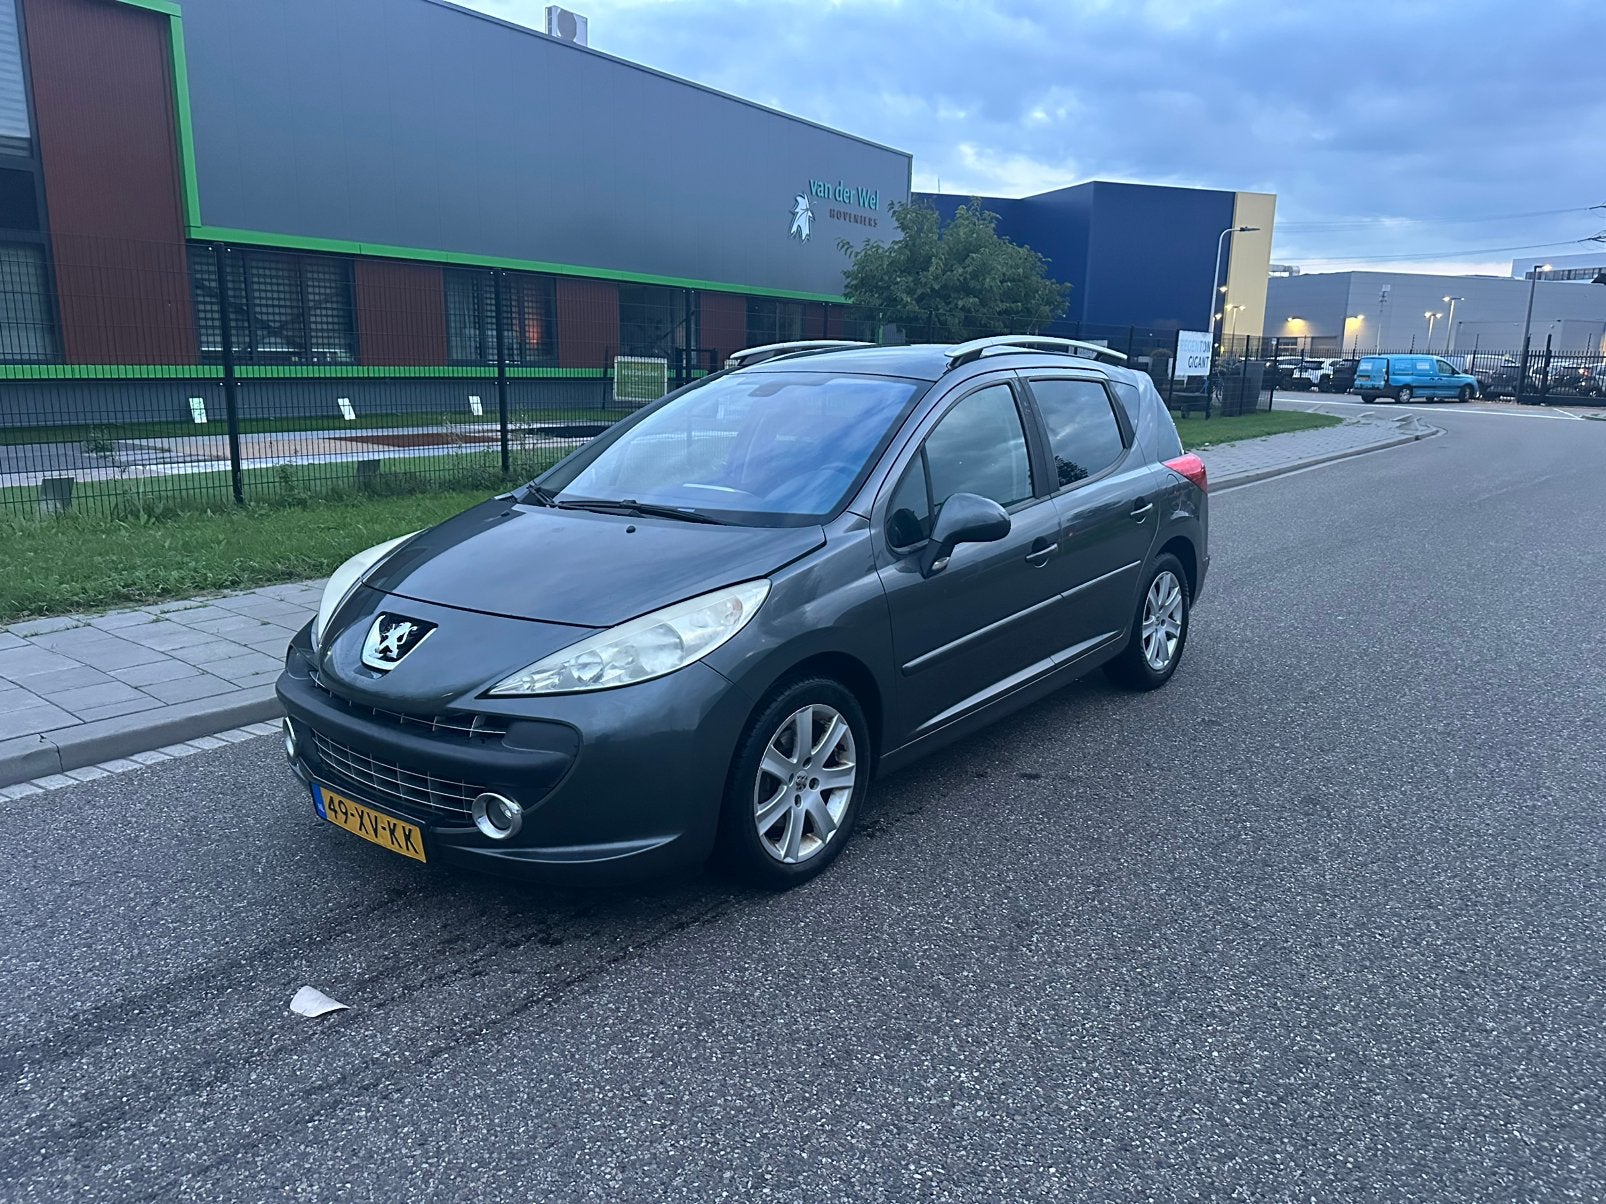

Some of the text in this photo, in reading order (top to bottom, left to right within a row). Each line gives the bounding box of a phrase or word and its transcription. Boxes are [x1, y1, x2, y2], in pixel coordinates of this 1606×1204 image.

[809, 180, 879, 210] van der Wel
[829, 208, 878, 228] HOVENIERS
[1188, 355, 1210, 368] GIGANT
[327, 795, 419, 854] 49-XV-KK
